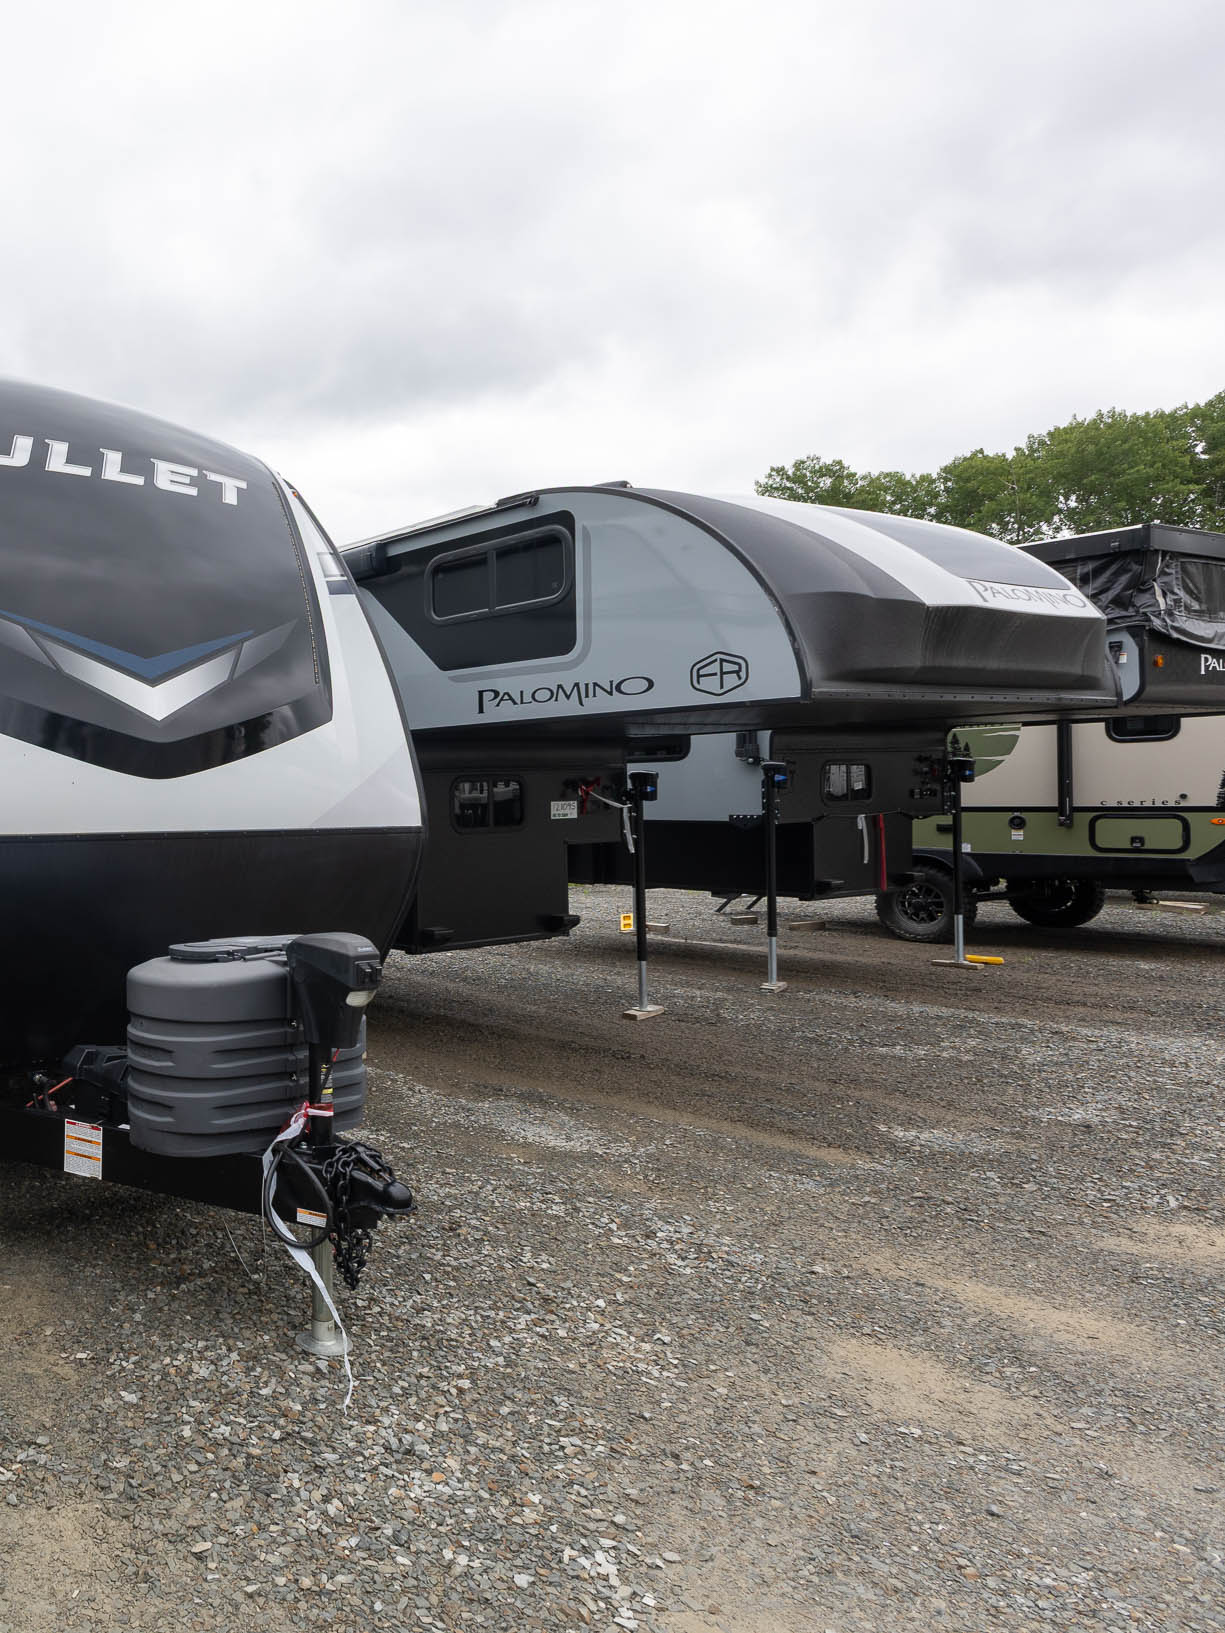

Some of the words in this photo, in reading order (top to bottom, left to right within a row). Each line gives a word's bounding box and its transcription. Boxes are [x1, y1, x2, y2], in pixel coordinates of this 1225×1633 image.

[966, 580, 1087, 609] PALOMINO
[477, 676, 655, 714] PALOMINO
[1116, 798, 1182, 806] series
